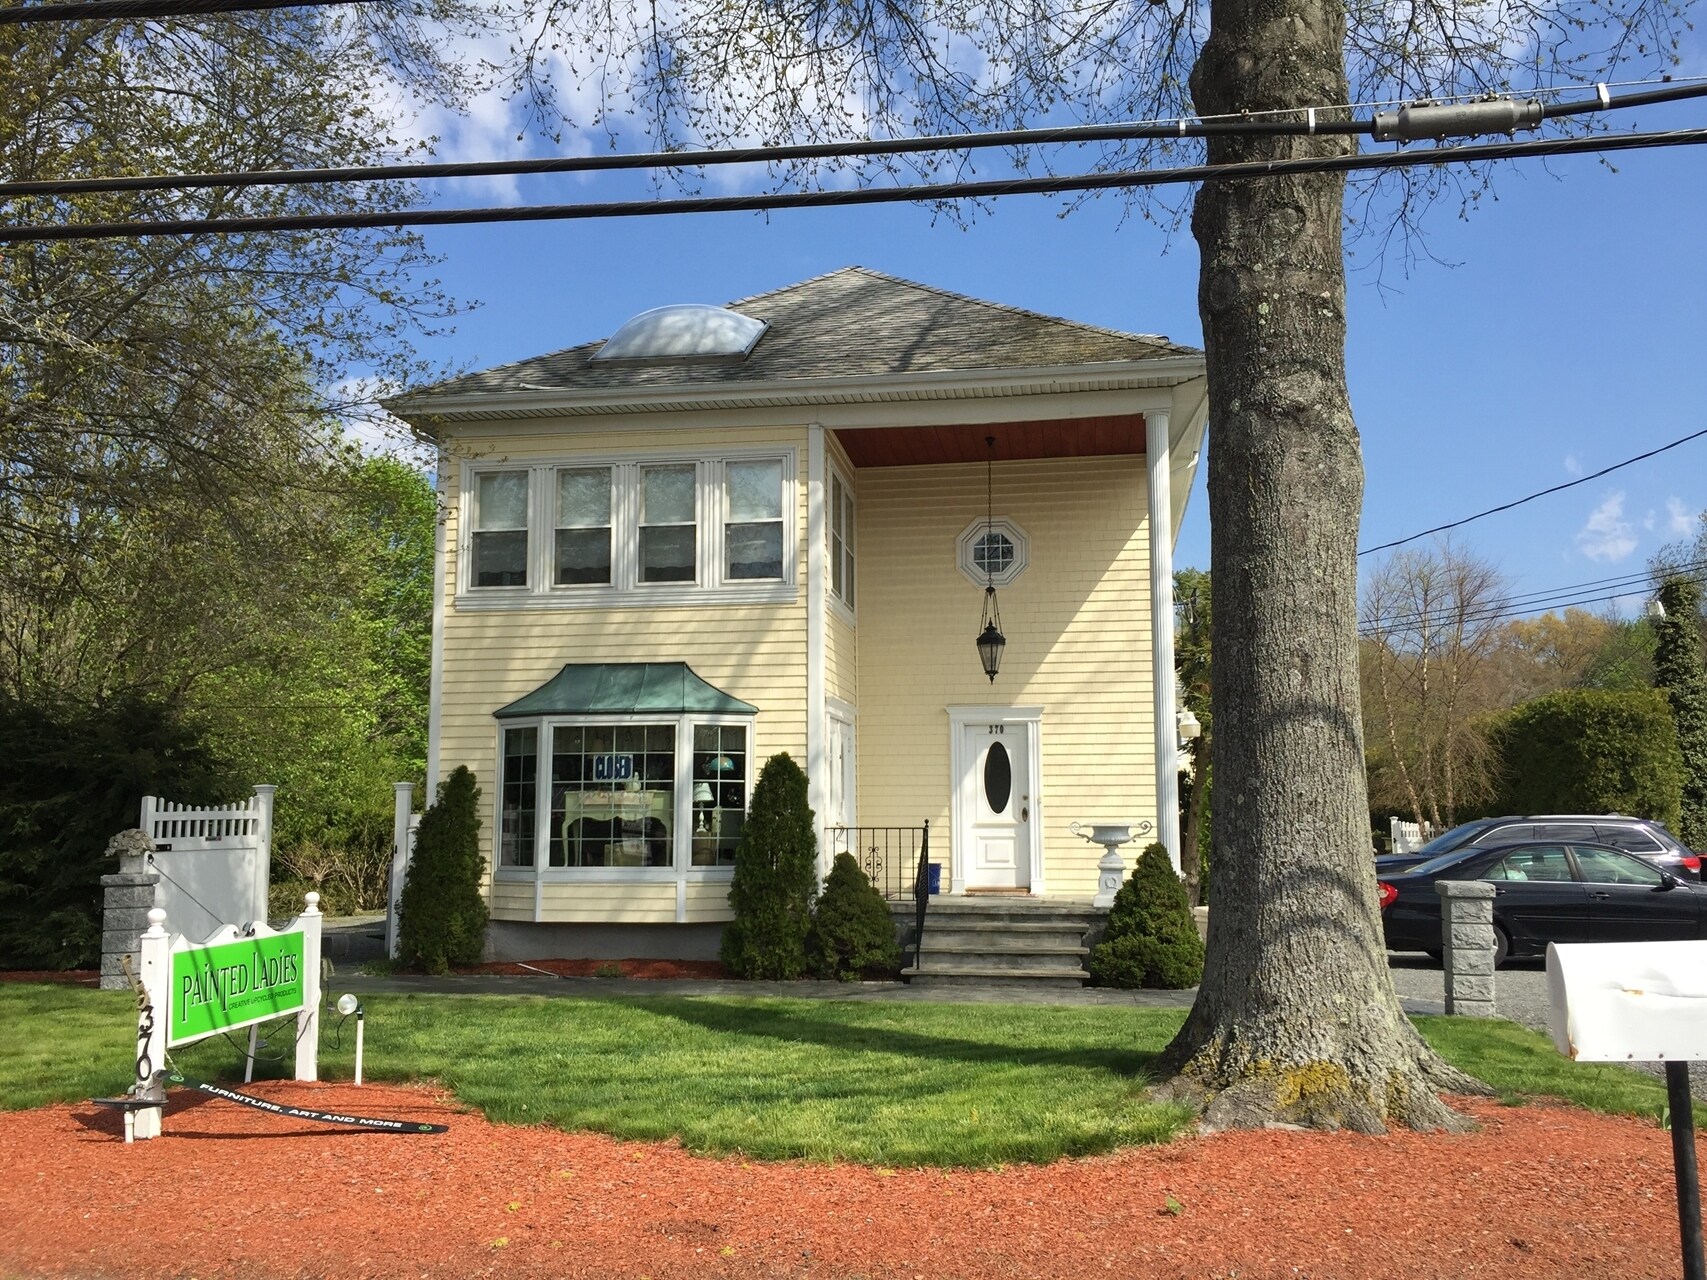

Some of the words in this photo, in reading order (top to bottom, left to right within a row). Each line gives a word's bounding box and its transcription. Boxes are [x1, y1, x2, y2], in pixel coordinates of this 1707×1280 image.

[988, 724, 1004, 734] 370
[200, 1083, 284, 1113] FURNITURE,
[288, 1109, 320, 1119] ART
[322, 1114, 355, 1124] AND
[359, 1118, 403, 1128] MORE
